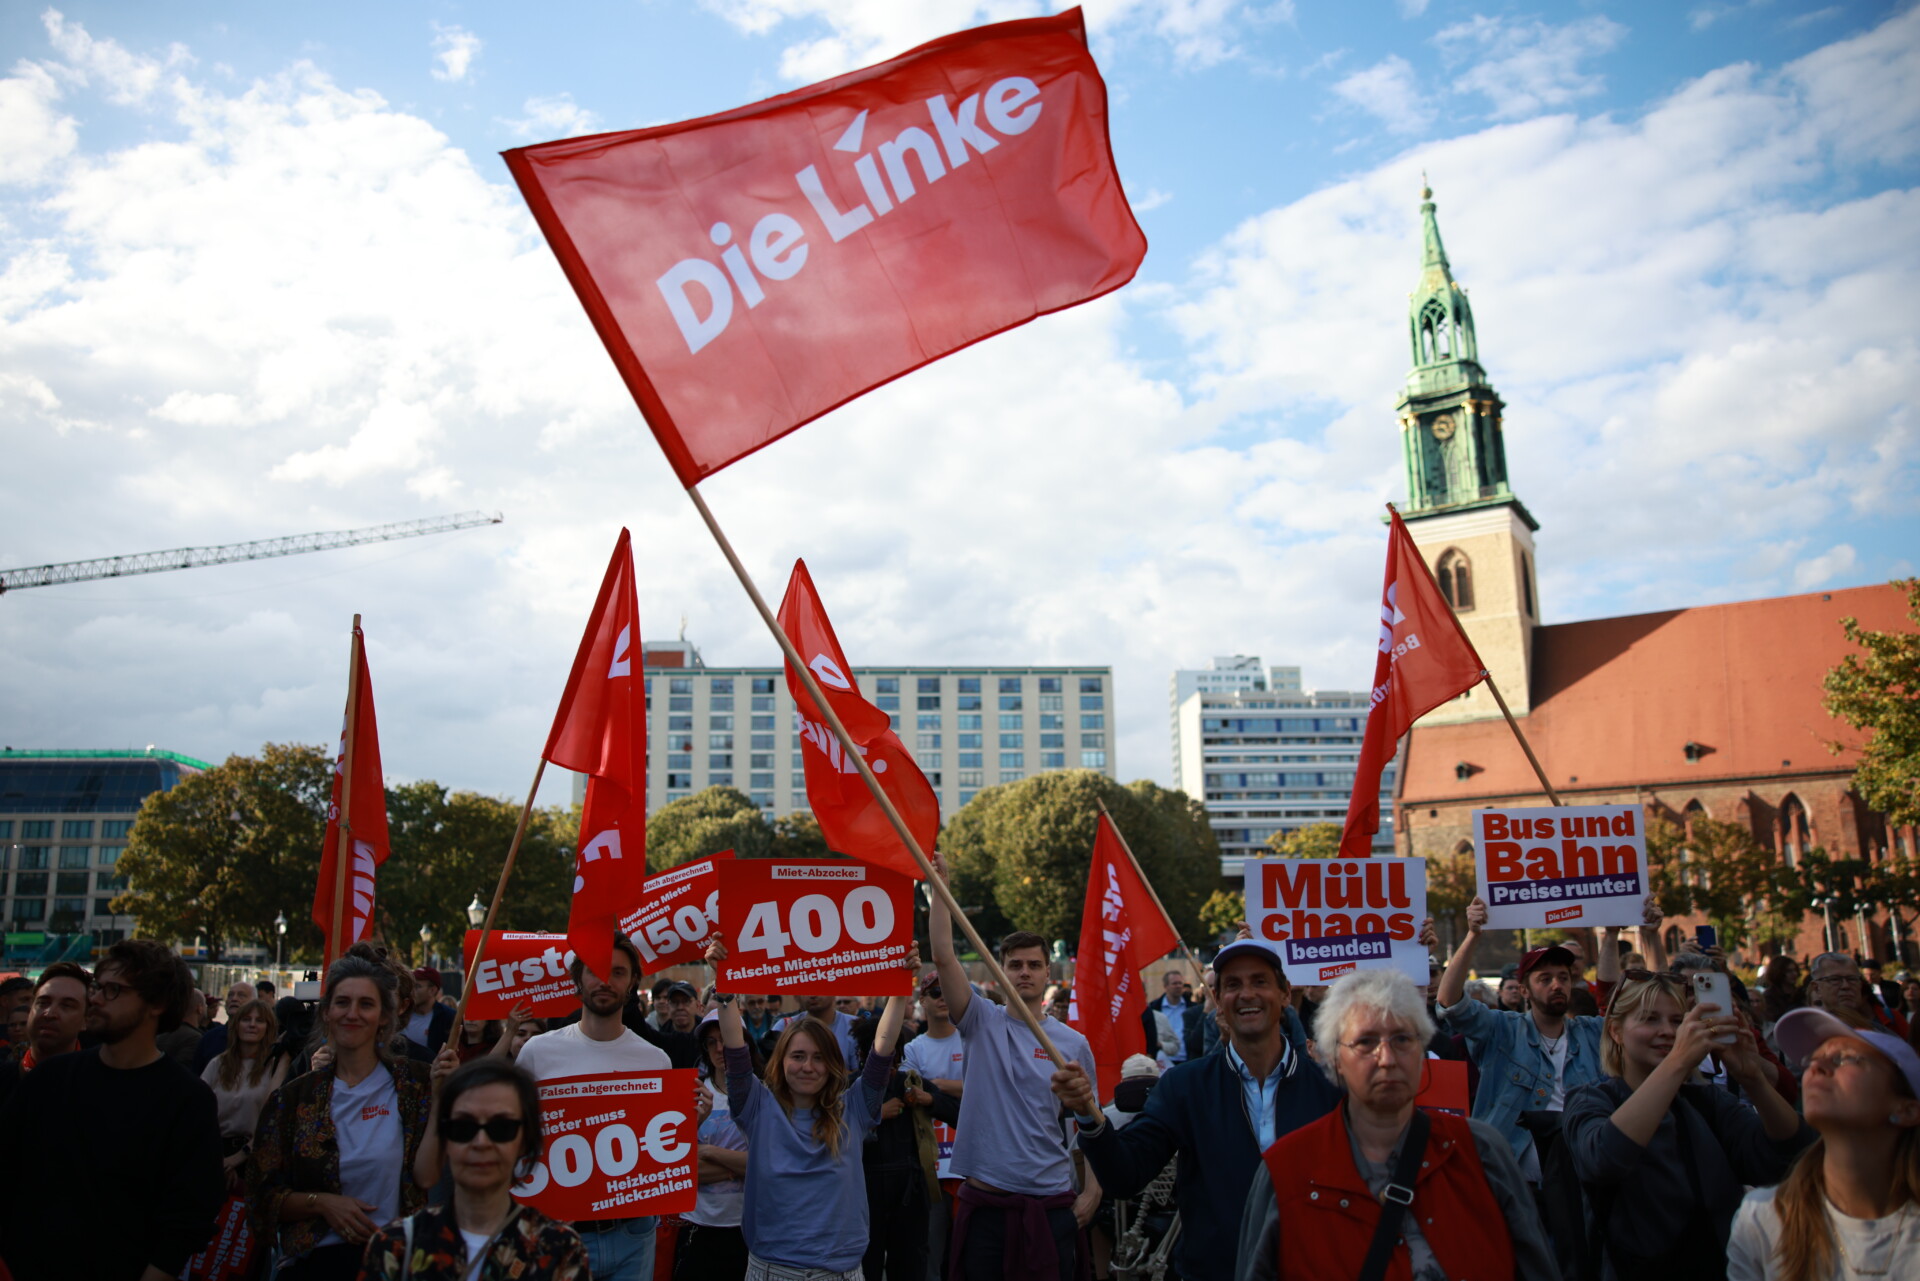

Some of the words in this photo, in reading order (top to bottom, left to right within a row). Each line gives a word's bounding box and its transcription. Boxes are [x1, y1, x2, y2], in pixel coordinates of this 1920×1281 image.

[656, 212, 809, 355] Die
[795, 76, 1043, 243] Linke
[1482, 813, 1556, 840] Bus
[1561, 810, 1635, 838] und
[777, 868, 859, 878] Miet-Abzocke:
[1484, 839, 1639, 882] Bahn
[642, 877, 660, 891] alsch
[661, 864, 710, 886] abgerechnet:
[1262, 862, 1411, 909] Müll
[1493, 883, 1563, 903] Preise
[1565, 878, 1636, 897] runter
[620, 900, 659, 926] Hunderte
[660, 883, 692, 903] Mieter
[621, 904, 671, 933] bekommen
[1548, 913, 1560, 921] Die
[1561, 909, 1580, 919] Linke
[737, 885, 895, 960] 400
[1261, 910, 1415, 941] chaos
[696, 936, 713, 949] Hei
[1291, 938, 1386, 960] beenden
[726, 962, 782, 981] falsche
[784, 944, 905, 972] Mieterhöhungen
[775, 957, 907, 987] zurückgenommen
[1322, 970, 1334, 979] Die
[498, 982, 559, 1001] Verurteilung
[540, 1082, 578, 1098] Falsch
[581, 1081, 657, 1095] abgerechnet:
[540, 1108, 566, 1122] ter
[585, 1109, 627, 1127] muss
[606, 1164, 691, 1194] Heizkosten
[592, 1178, 693, 1212] zurückzahlen
